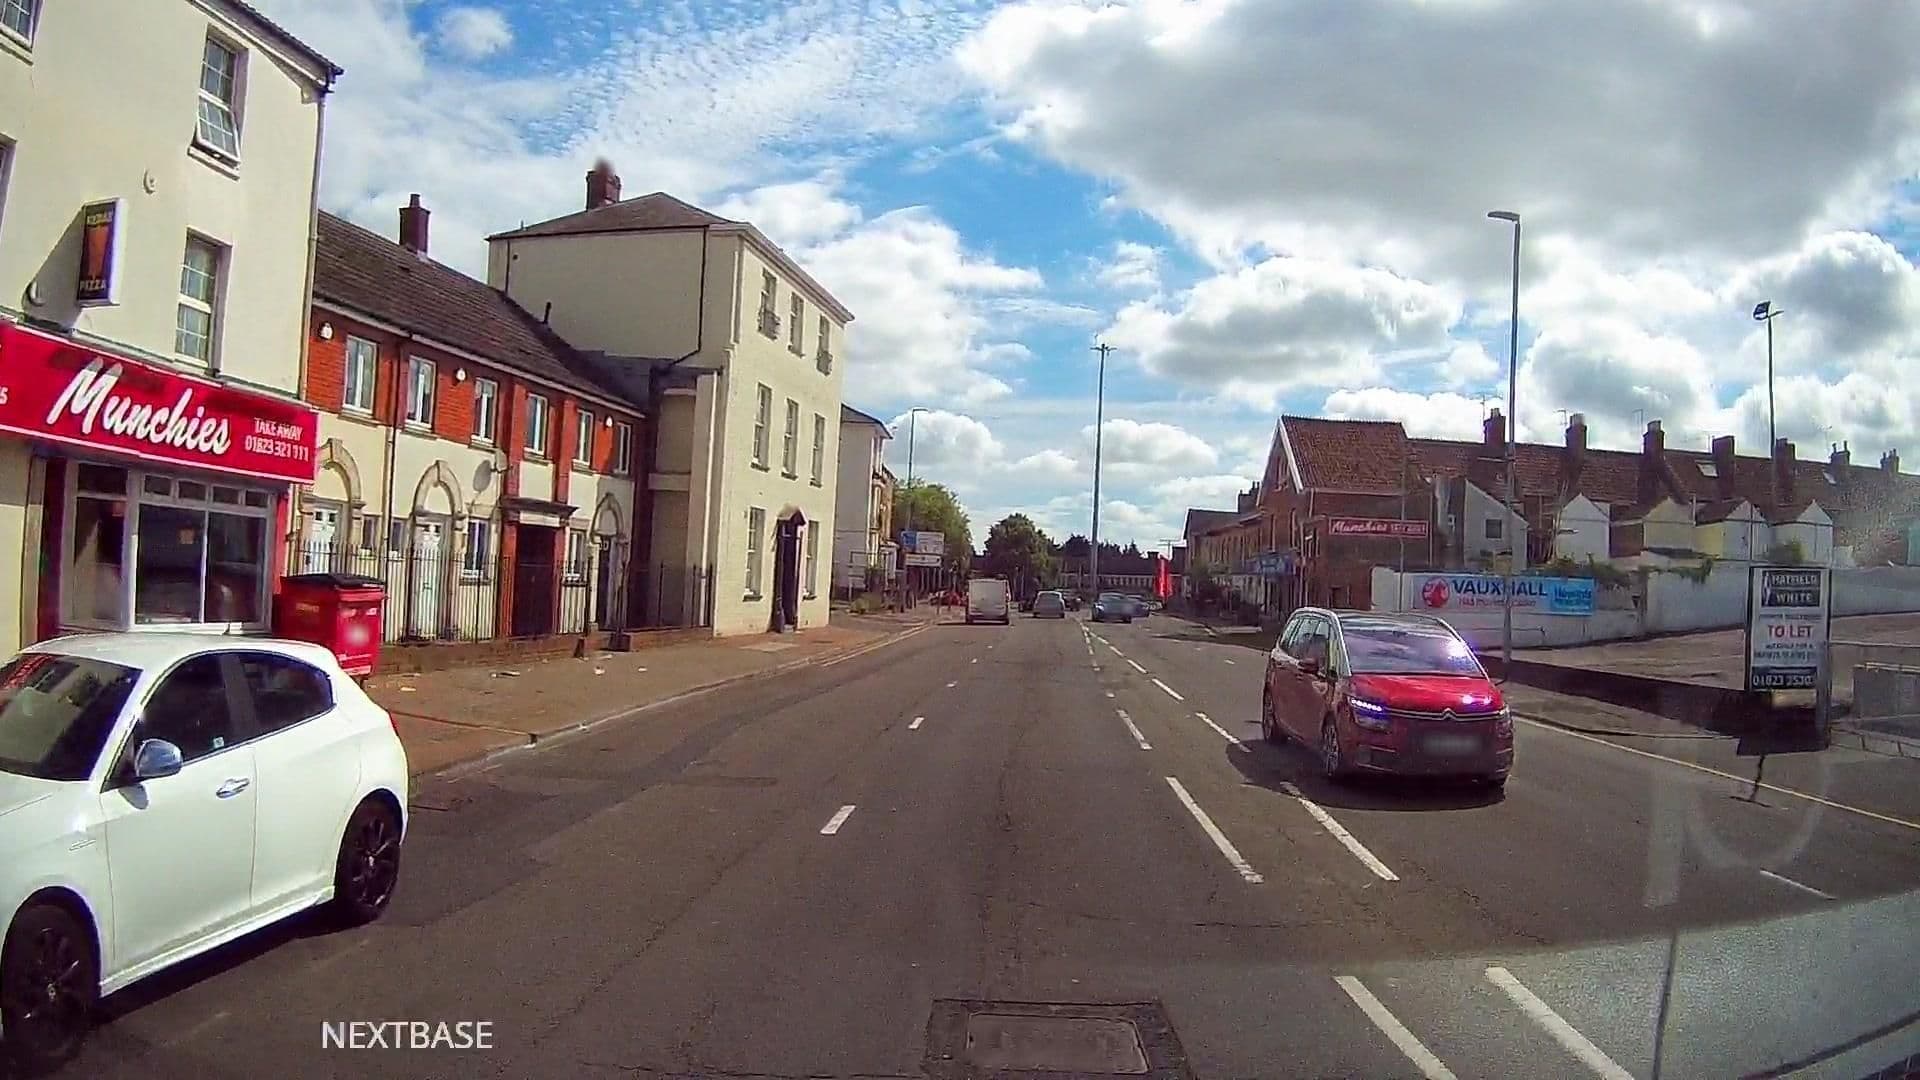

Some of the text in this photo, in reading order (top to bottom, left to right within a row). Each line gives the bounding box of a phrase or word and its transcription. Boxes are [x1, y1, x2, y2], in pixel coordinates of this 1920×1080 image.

[79, 279, 107, 291] PIZZA
[47, 357, 231, 455] Munchies
[1452, 579, 1548, 596] VAUXHALL
[1776, 593, 1812, 603] WHITE
[1768, 624, 1813, 638] TO LET
